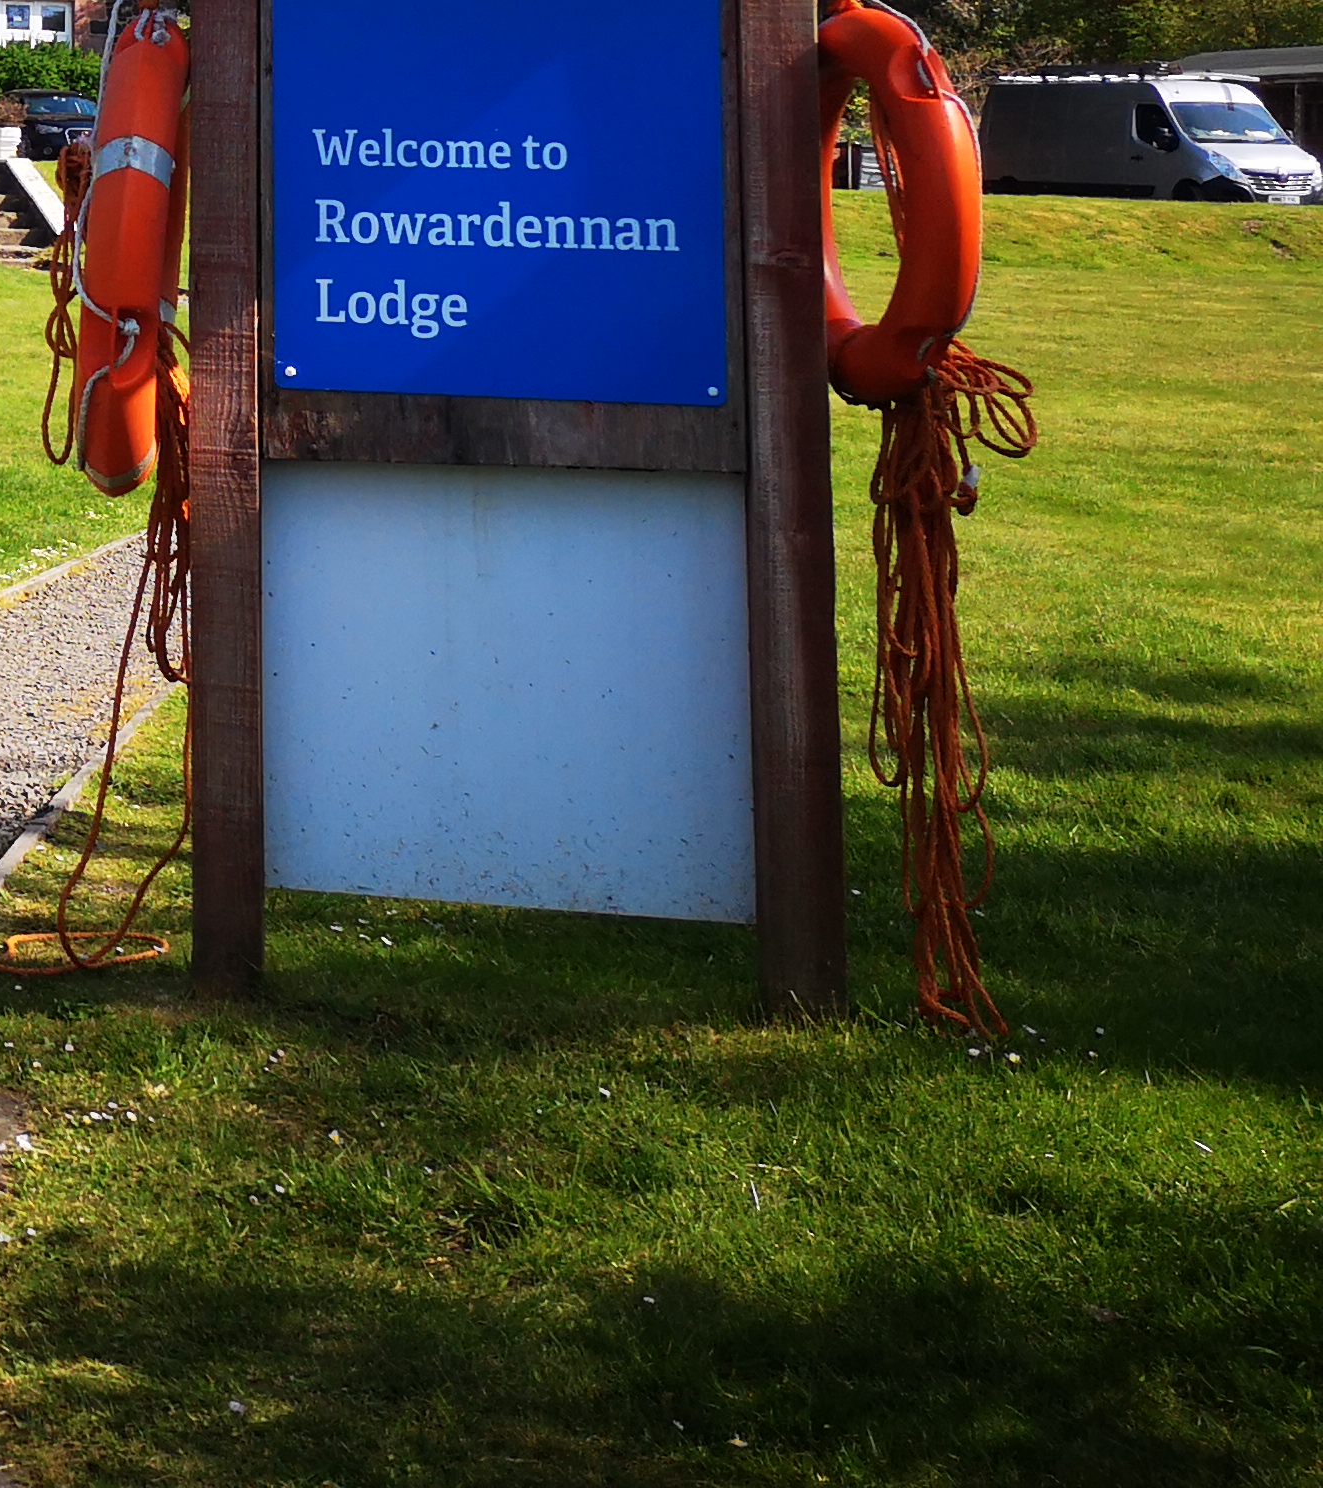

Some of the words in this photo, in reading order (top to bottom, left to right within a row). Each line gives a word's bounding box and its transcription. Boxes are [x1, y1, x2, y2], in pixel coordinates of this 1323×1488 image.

[312, 128, 511, 169] Welcome
[522, 135, 568, 170] to
[314, 199, 680, 252] Rowardennan
[315, 278, 468, 339] Lodge
